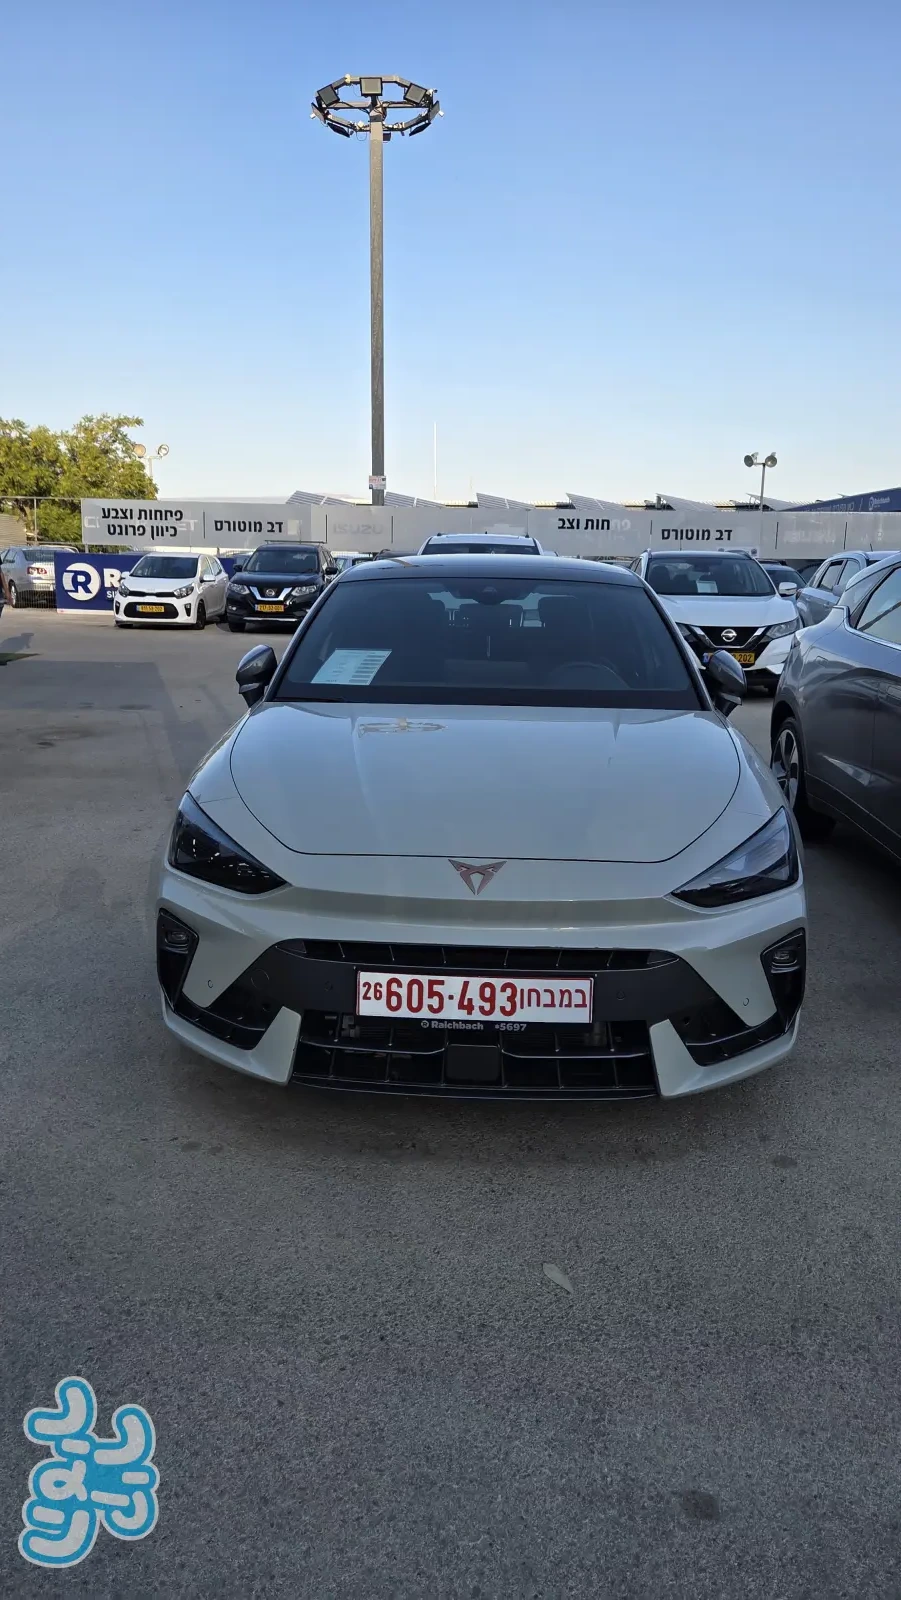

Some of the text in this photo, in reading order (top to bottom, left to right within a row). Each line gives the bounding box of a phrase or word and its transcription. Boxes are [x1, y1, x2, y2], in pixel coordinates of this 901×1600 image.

[102, 507, 133, 519] וצבע
[107, 523, 177, 540] כיוון פרונט
[214, 519, 283, 533] דב מוטורס
[661, 528, 733, 541] דב מוטורס
[362, 981, 383, 1001] 26
[520, 988, 588, 1010] במבחן
